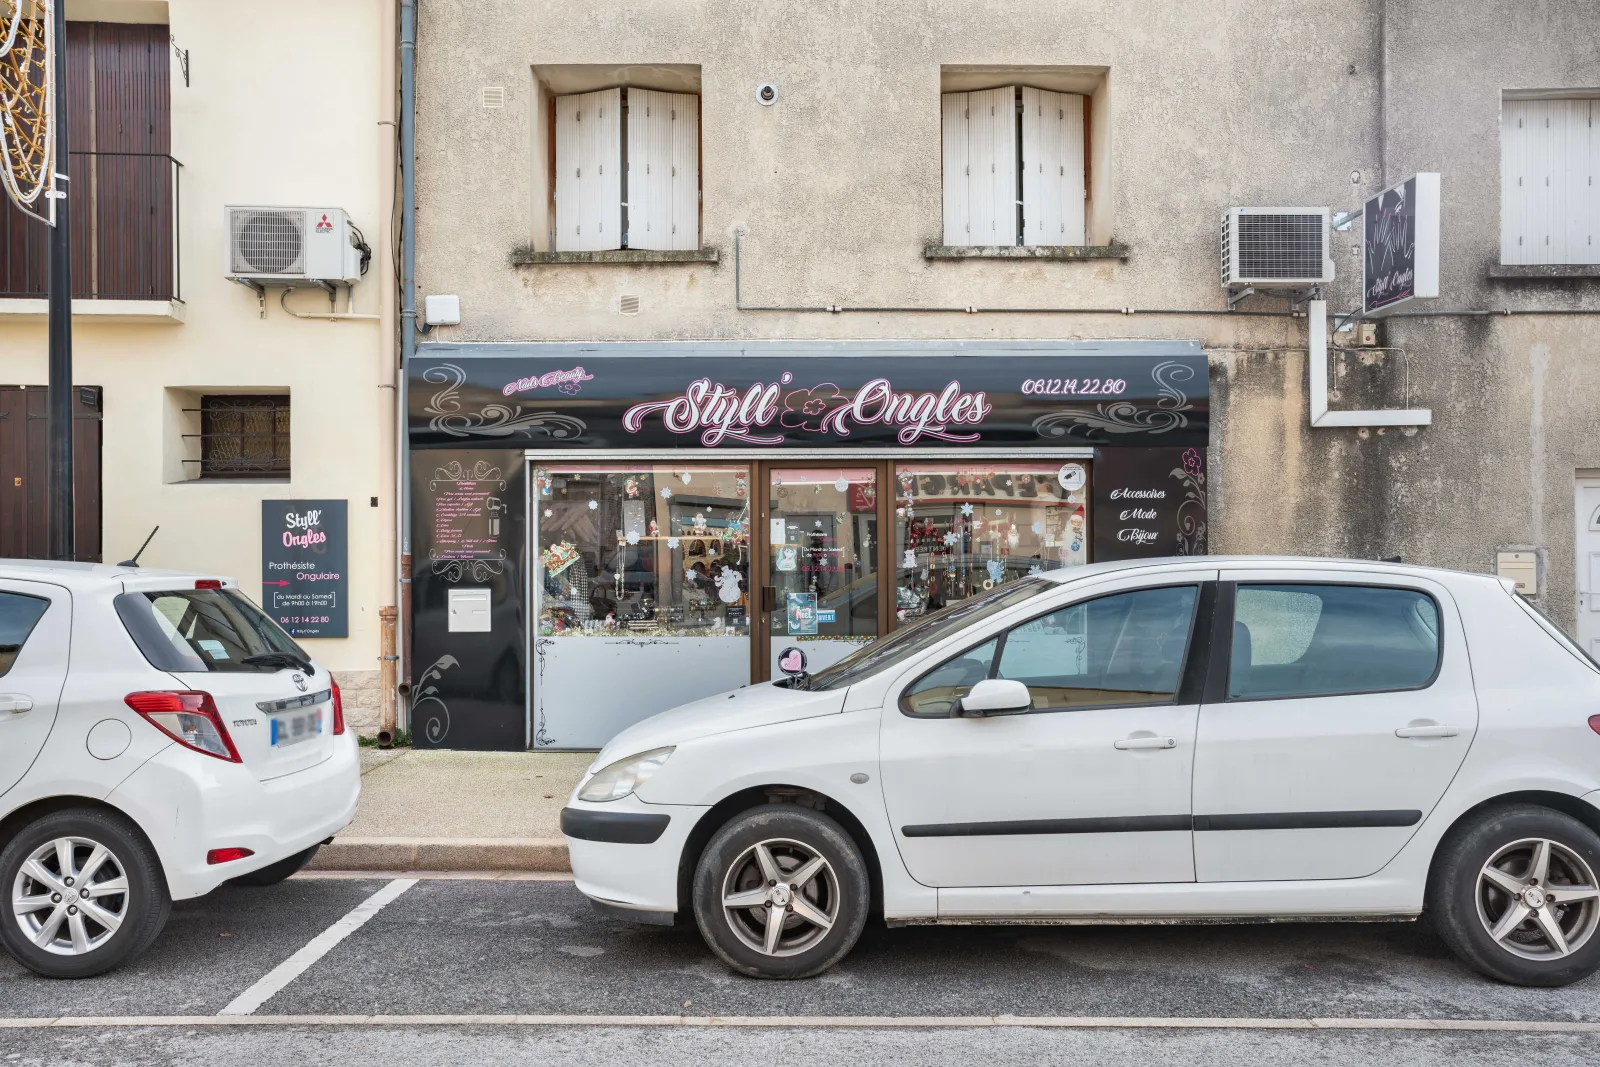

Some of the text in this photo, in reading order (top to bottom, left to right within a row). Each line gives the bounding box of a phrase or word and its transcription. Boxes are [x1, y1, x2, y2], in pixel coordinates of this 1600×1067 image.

[503, 366, 595, 397] Nails Beauty
[1021, 378, 1127, 396] 06.12.14.22.80
[821, 378, 992, 445] Ongles
[1110, 487, 1167, 500] Accessoires
[1119, 508, 1157, 521] Mode
[282, 529, 327, 548] Ongles
[268, 562, 316, 570] Prothésiste
[296, 572, 340, 582] Ongulaire
[232, 718, 258, 727] TOYOTA
